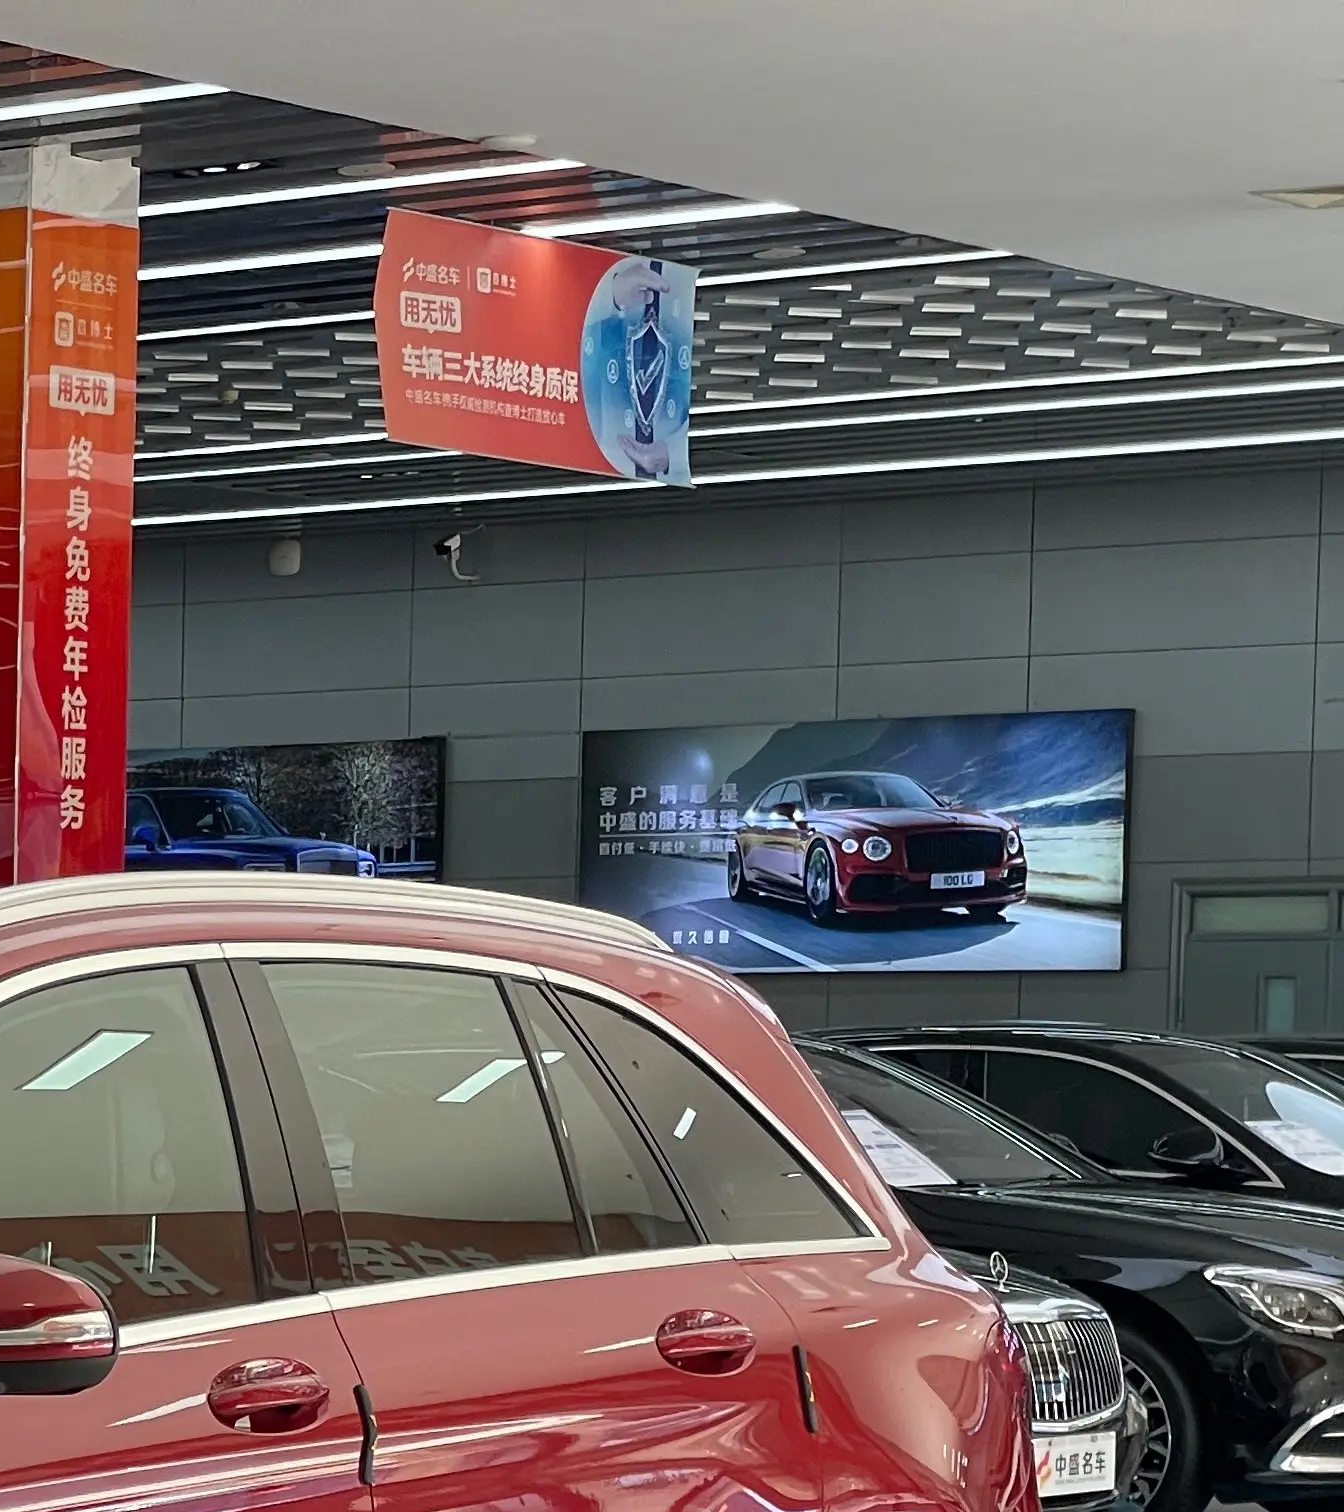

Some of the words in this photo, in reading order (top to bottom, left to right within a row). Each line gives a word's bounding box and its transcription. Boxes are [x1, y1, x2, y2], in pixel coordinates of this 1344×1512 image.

[68, 267, 118, 297] 中盛名车
[416, 262, 460, 286] 中盛名车
[404, 296, 456, 328] 用无忧
[402, 343, 579, 404] 车辆三大系统终身质保
[57, 373, 108, 407] 用无忧
[59, 435, 95, 831] 终身免费年检服务
[1056, 1450, 1105, 1478] 中盛名车
